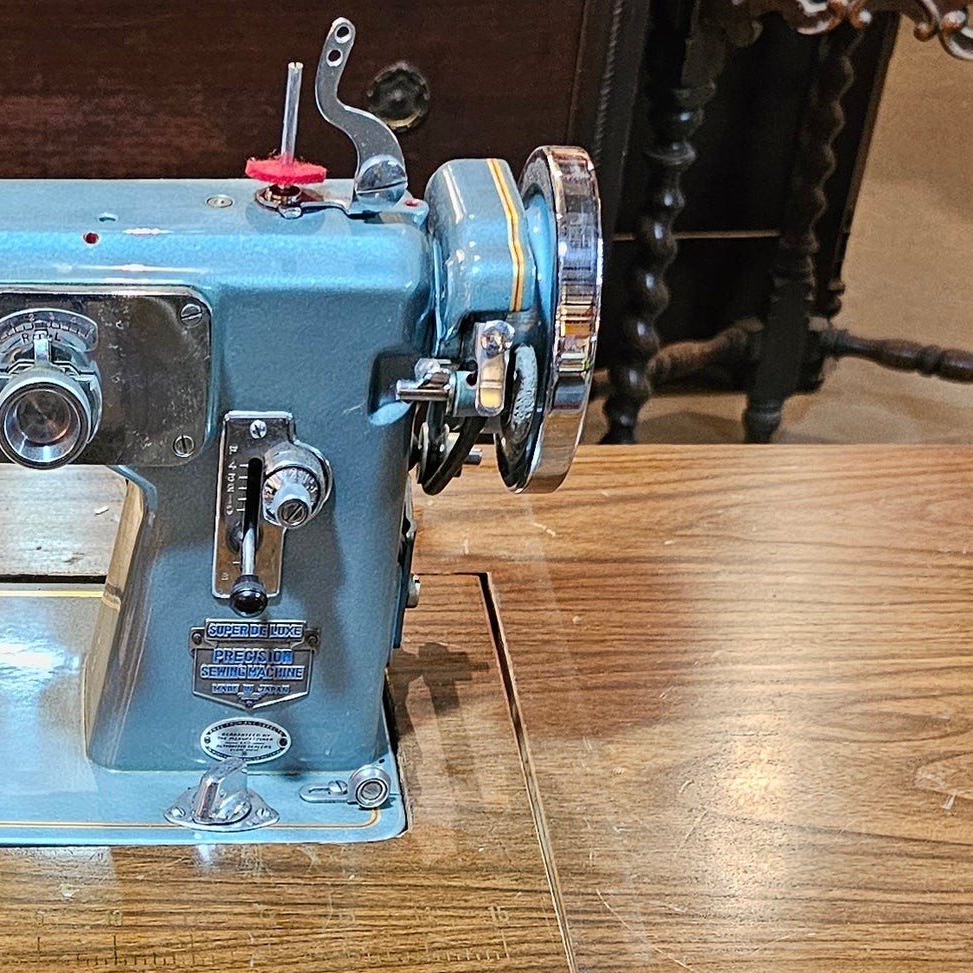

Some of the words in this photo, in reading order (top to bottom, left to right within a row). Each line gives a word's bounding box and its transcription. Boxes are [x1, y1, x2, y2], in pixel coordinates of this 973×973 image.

[208, 623, 249, 637] SUPER
[250, 624, 267, 637] DE
[269, 624, 304, 638] LUXE
[213, 648, 294, 664] PRECISION
[200, 664, 246, 678] SEWING
[247, 665, 305, 679] MACHINE
[258, 684, 290, 694] JAPAN
